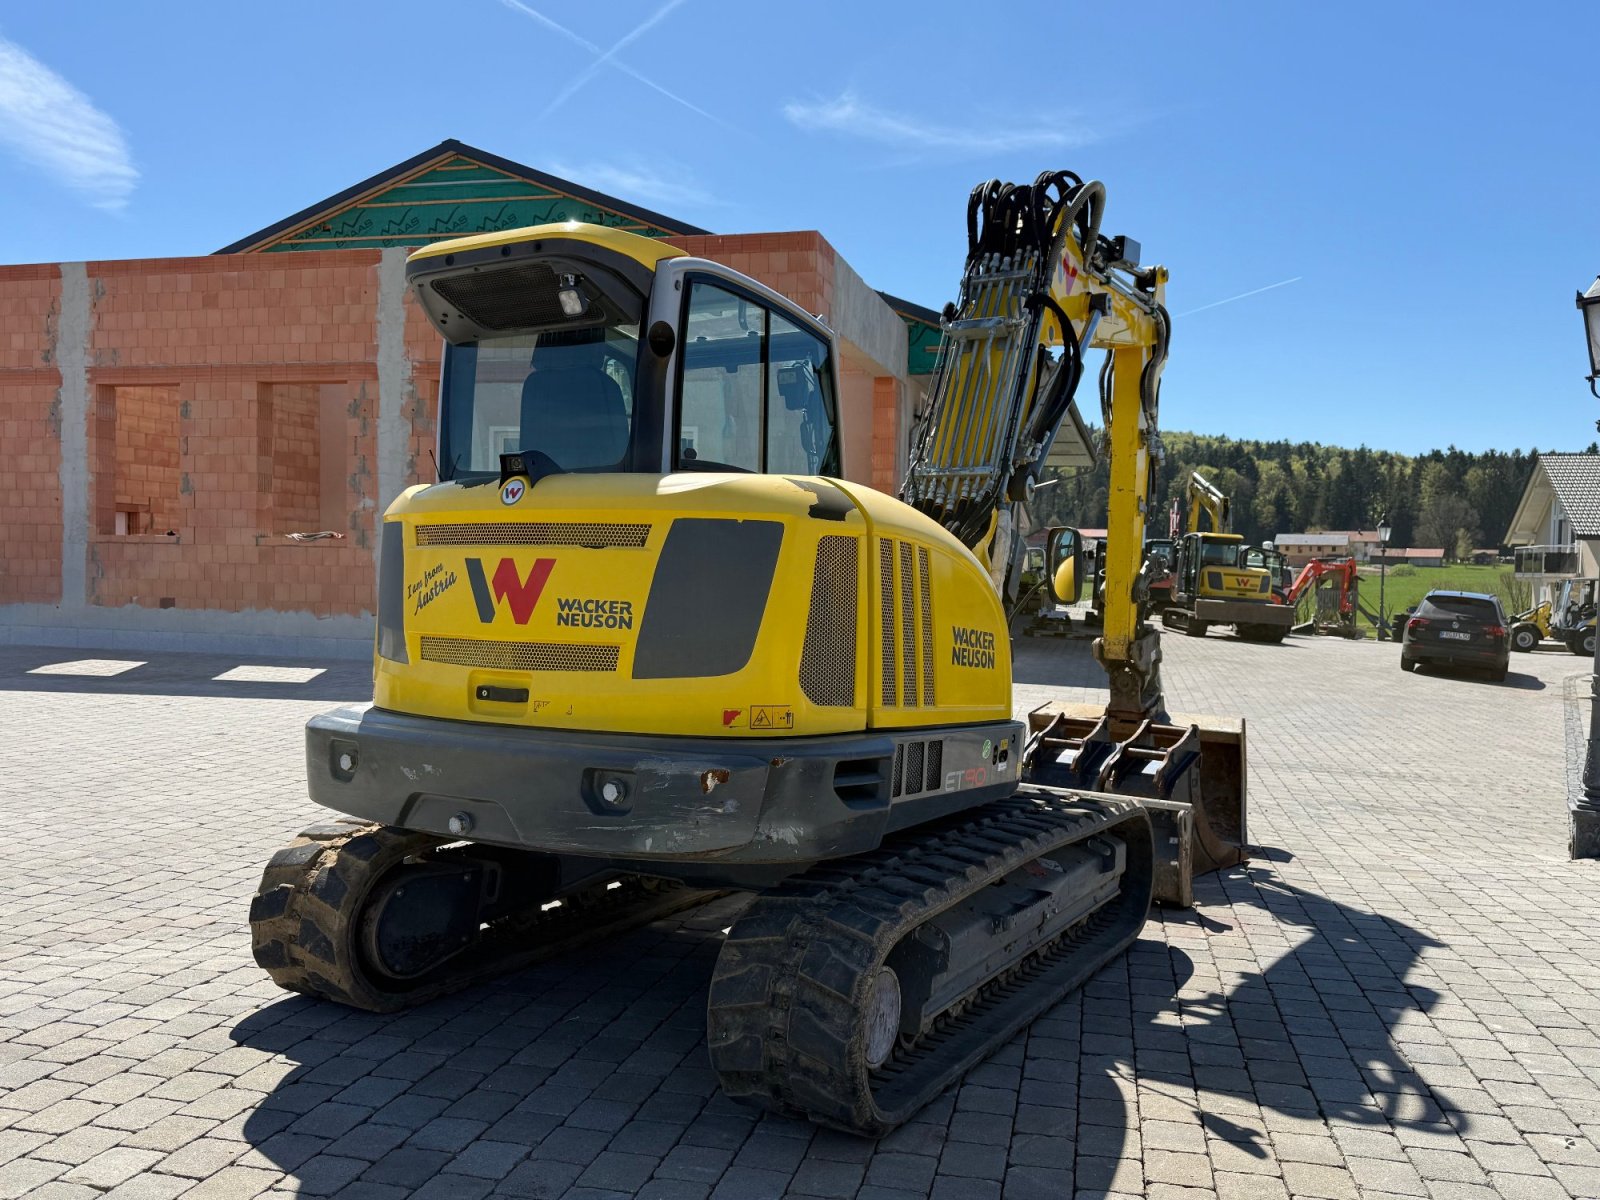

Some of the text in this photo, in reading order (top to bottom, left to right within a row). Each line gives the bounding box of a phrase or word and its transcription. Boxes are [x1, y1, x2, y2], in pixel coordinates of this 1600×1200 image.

[412, 579, 423, 594] am
[424, 563, 443, 588] from
[414, 571, 458, 616] Austria
[465, 558, 557, 625] W
[556, 597, 633, 616] WACKER
[556, 612, 633, 630] NEUSON
[952, 626, 995, 651] WACKER
[951, 647, 995, 669] NEUSON
[945, 767, 987, 792] ET90
